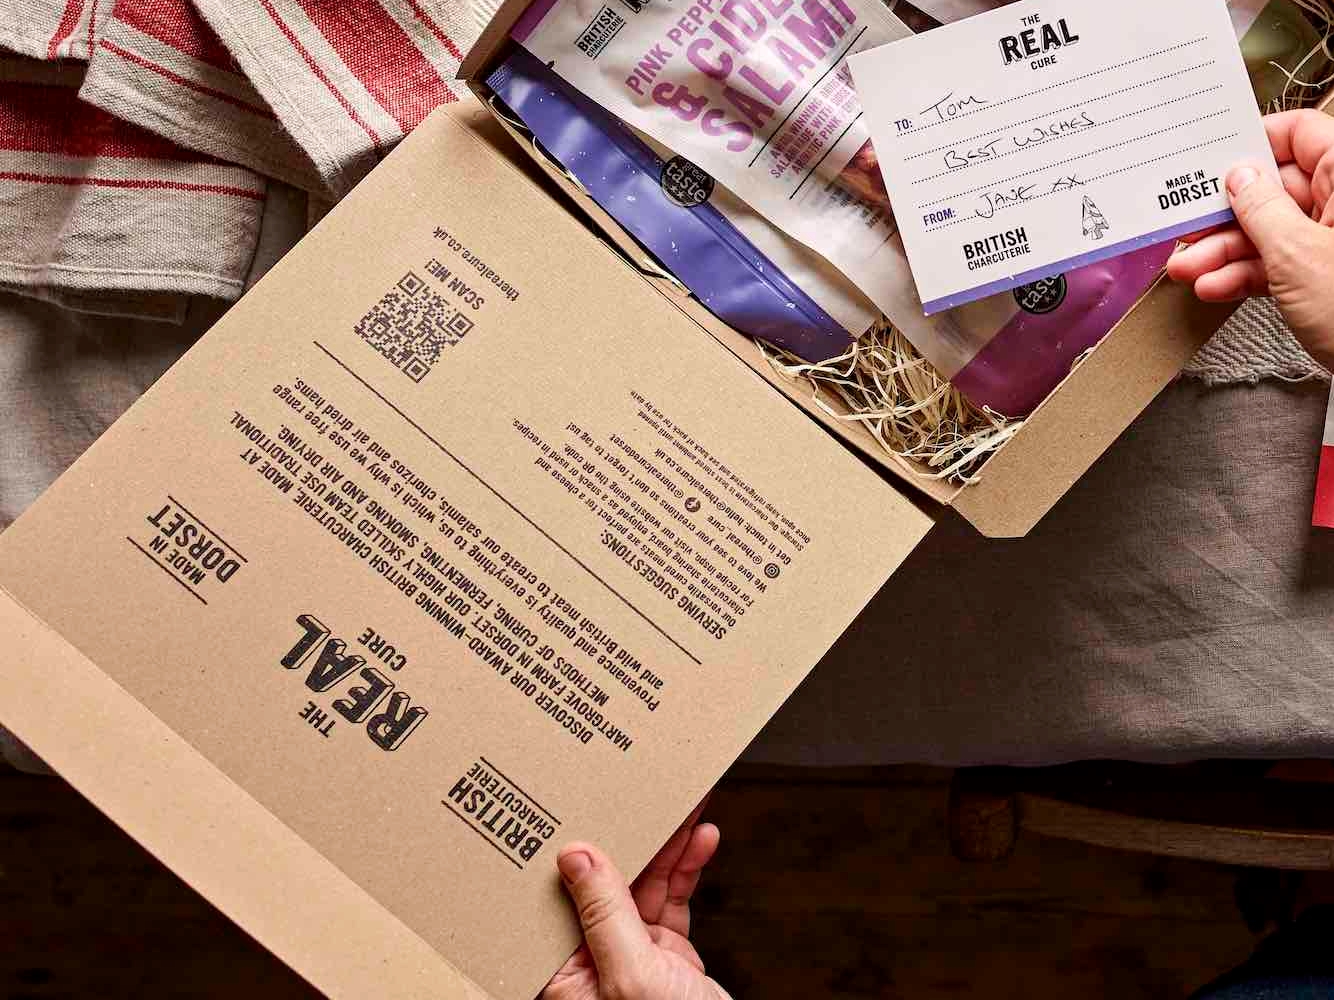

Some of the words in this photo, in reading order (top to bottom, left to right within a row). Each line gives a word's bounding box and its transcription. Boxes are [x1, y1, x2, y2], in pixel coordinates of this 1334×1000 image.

[573, 7, 620, 53] BRITISH
[1020, 13, 1041, 27] THE
[999, 18, 1080, 63] REAL
[625, 43, 674, 96] PINK
[1030, 54, 1057, 71] CURE
[652, 82, 710, 122] &
[893, 118, 913, 132] TO:
[1157, 177, 1220, 210] DORSET
[1165, 173, 1193, 190] MADE
[1193, 169, 1205, 181] IN
[923, 207, 957, 226] FROM:
[962, 226, 1028, 260] BRITISH
[967, 243, 1031, 271] CHARCUTERIE
[424, 258, 452, 283] ME!
[432, 226, 520, 302] therealcure.co.uk
[447, 277, 485, 311] SCAN
[655, 448, 747, 526] hello@therealcure.co.uk
[146, 504, 241, 584] DORSET
[148, 535, 169, 555] IN
[744, 523, 771, 546] touch:
[766, 542, 778, 553] in
[164, 549, 206, 585] MADE
[776, 551, 792, 567] Get
[357, 627, 407, 672] CURE
[279, 613, 429, 752] REAL
[298, 700, 336, 739] THE
[466, 762, 555, 840] CHARCUTERIE
[447, 776, 543, 862] BRITISH
